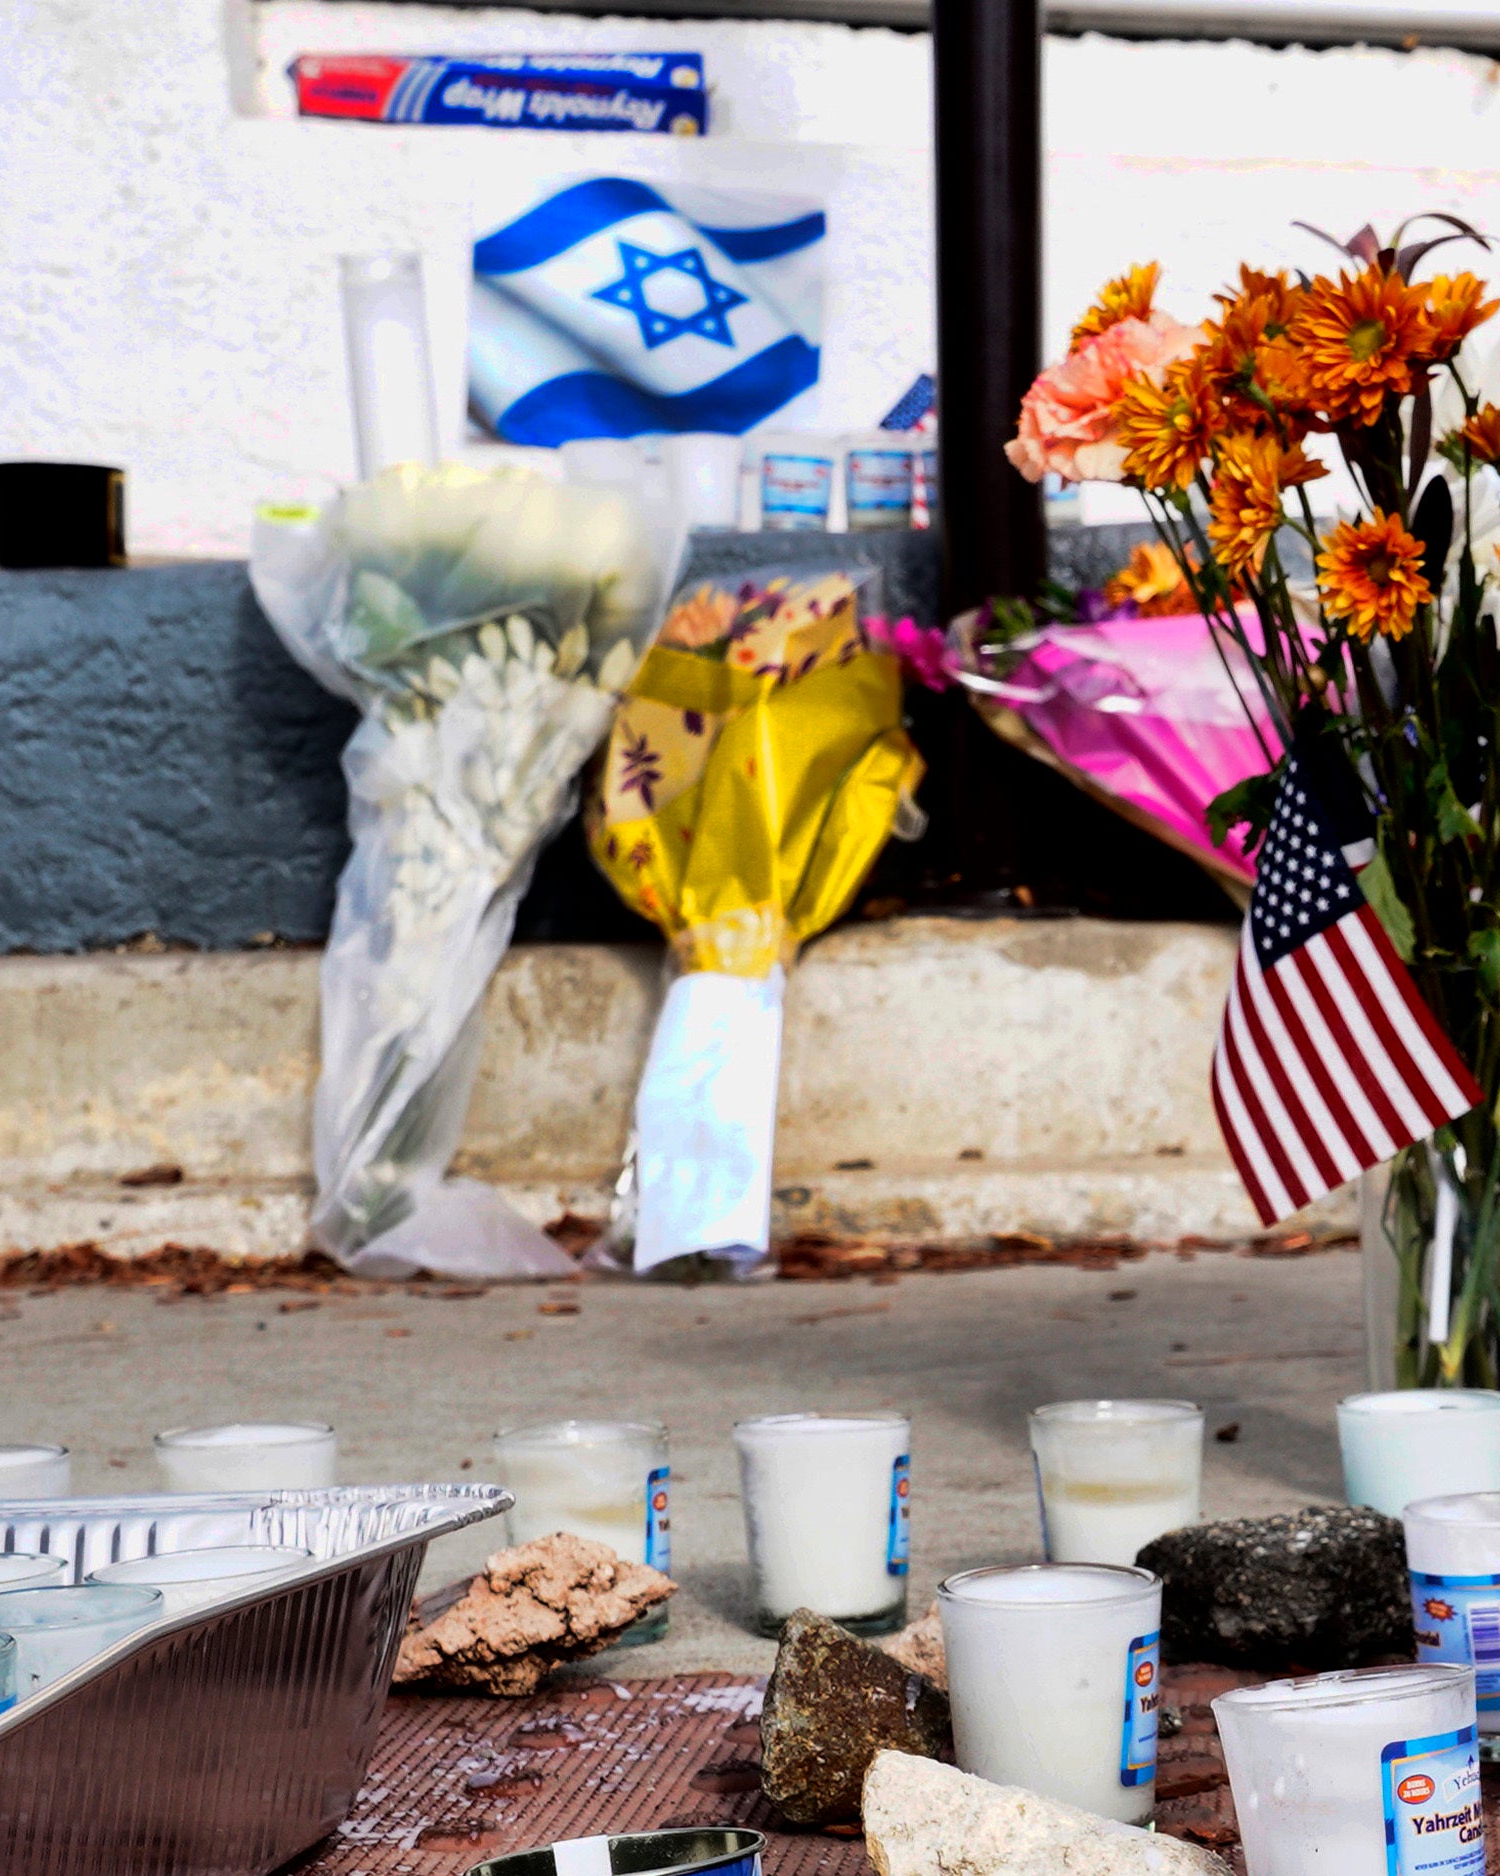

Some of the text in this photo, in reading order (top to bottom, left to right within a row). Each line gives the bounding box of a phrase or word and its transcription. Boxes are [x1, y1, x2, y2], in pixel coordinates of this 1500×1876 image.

[443, 75, 666, 130] Reynolds Wrap
[1411, 1805, 1472, 1835] Yahrzeit
